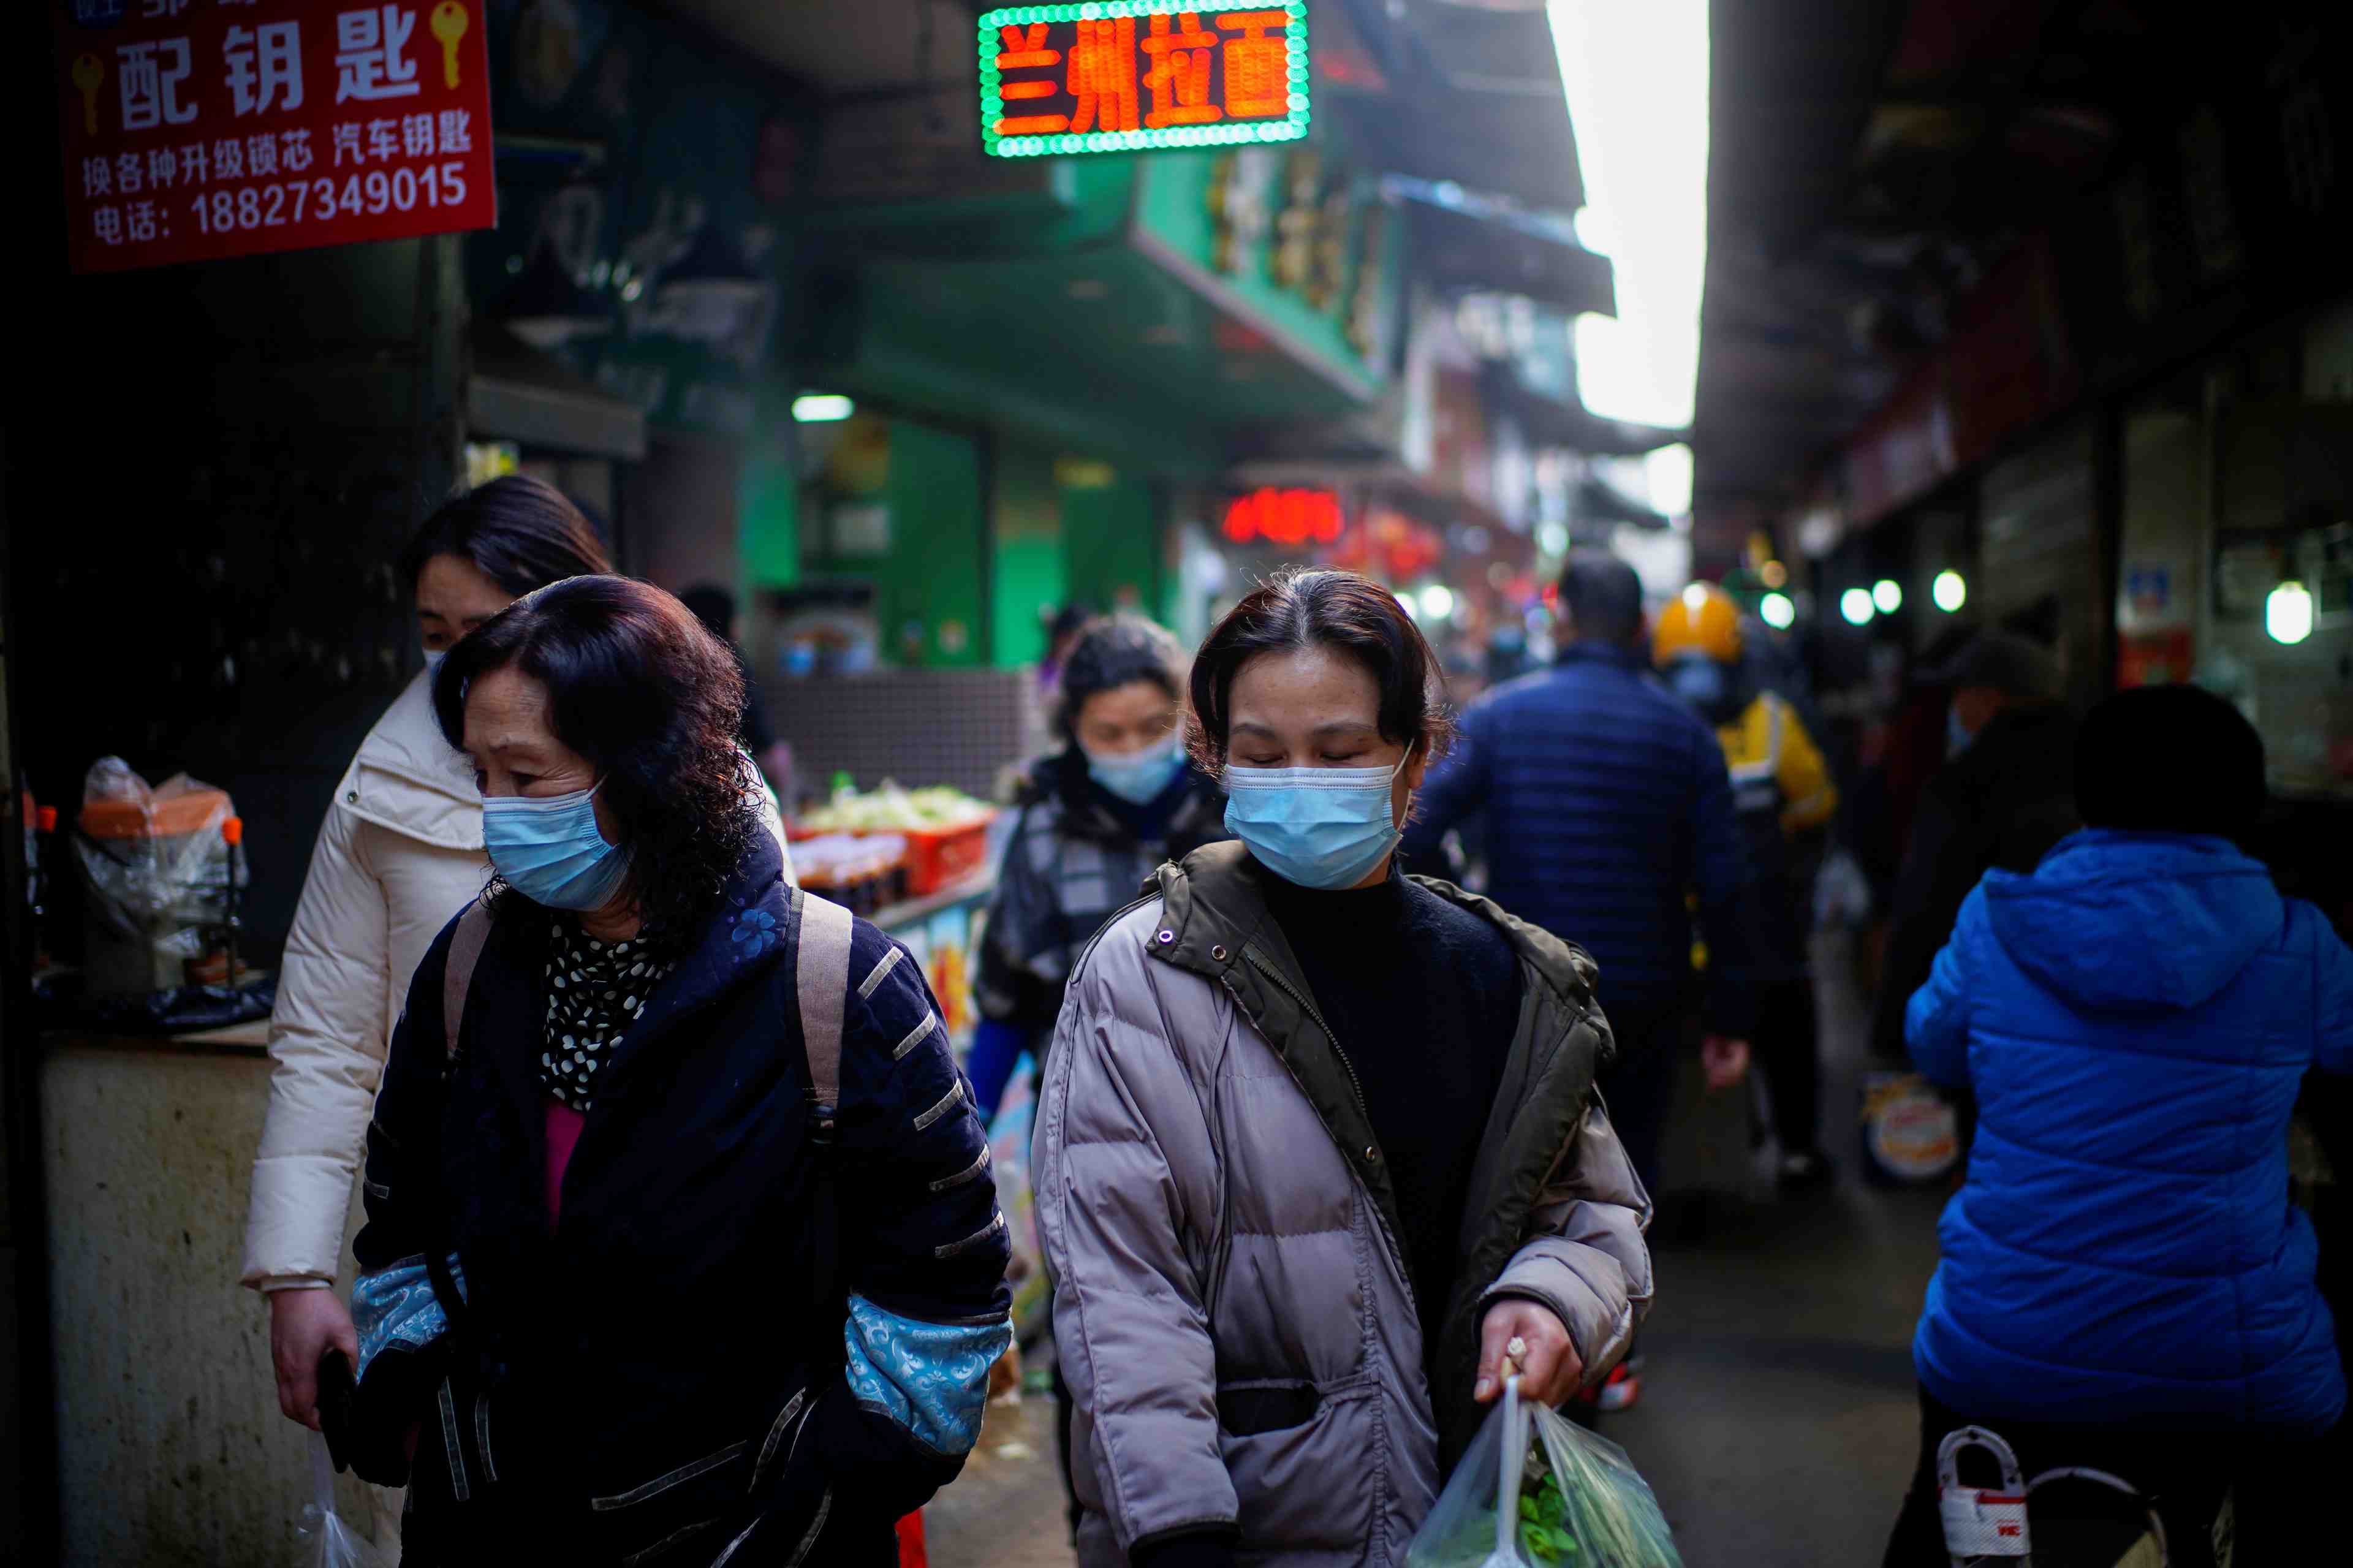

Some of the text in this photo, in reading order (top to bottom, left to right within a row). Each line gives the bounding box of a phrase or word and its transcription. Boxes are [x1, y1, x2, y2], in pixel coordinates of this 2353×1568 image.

[116, 4, 420, 131] 配钥匙
[993, 10, 1293, 135] 兰州拉面
[82, 109, 471, 197] 换各种升级锁芯 汽车钥匙
[191, 162, 466, 234] 18827349015
